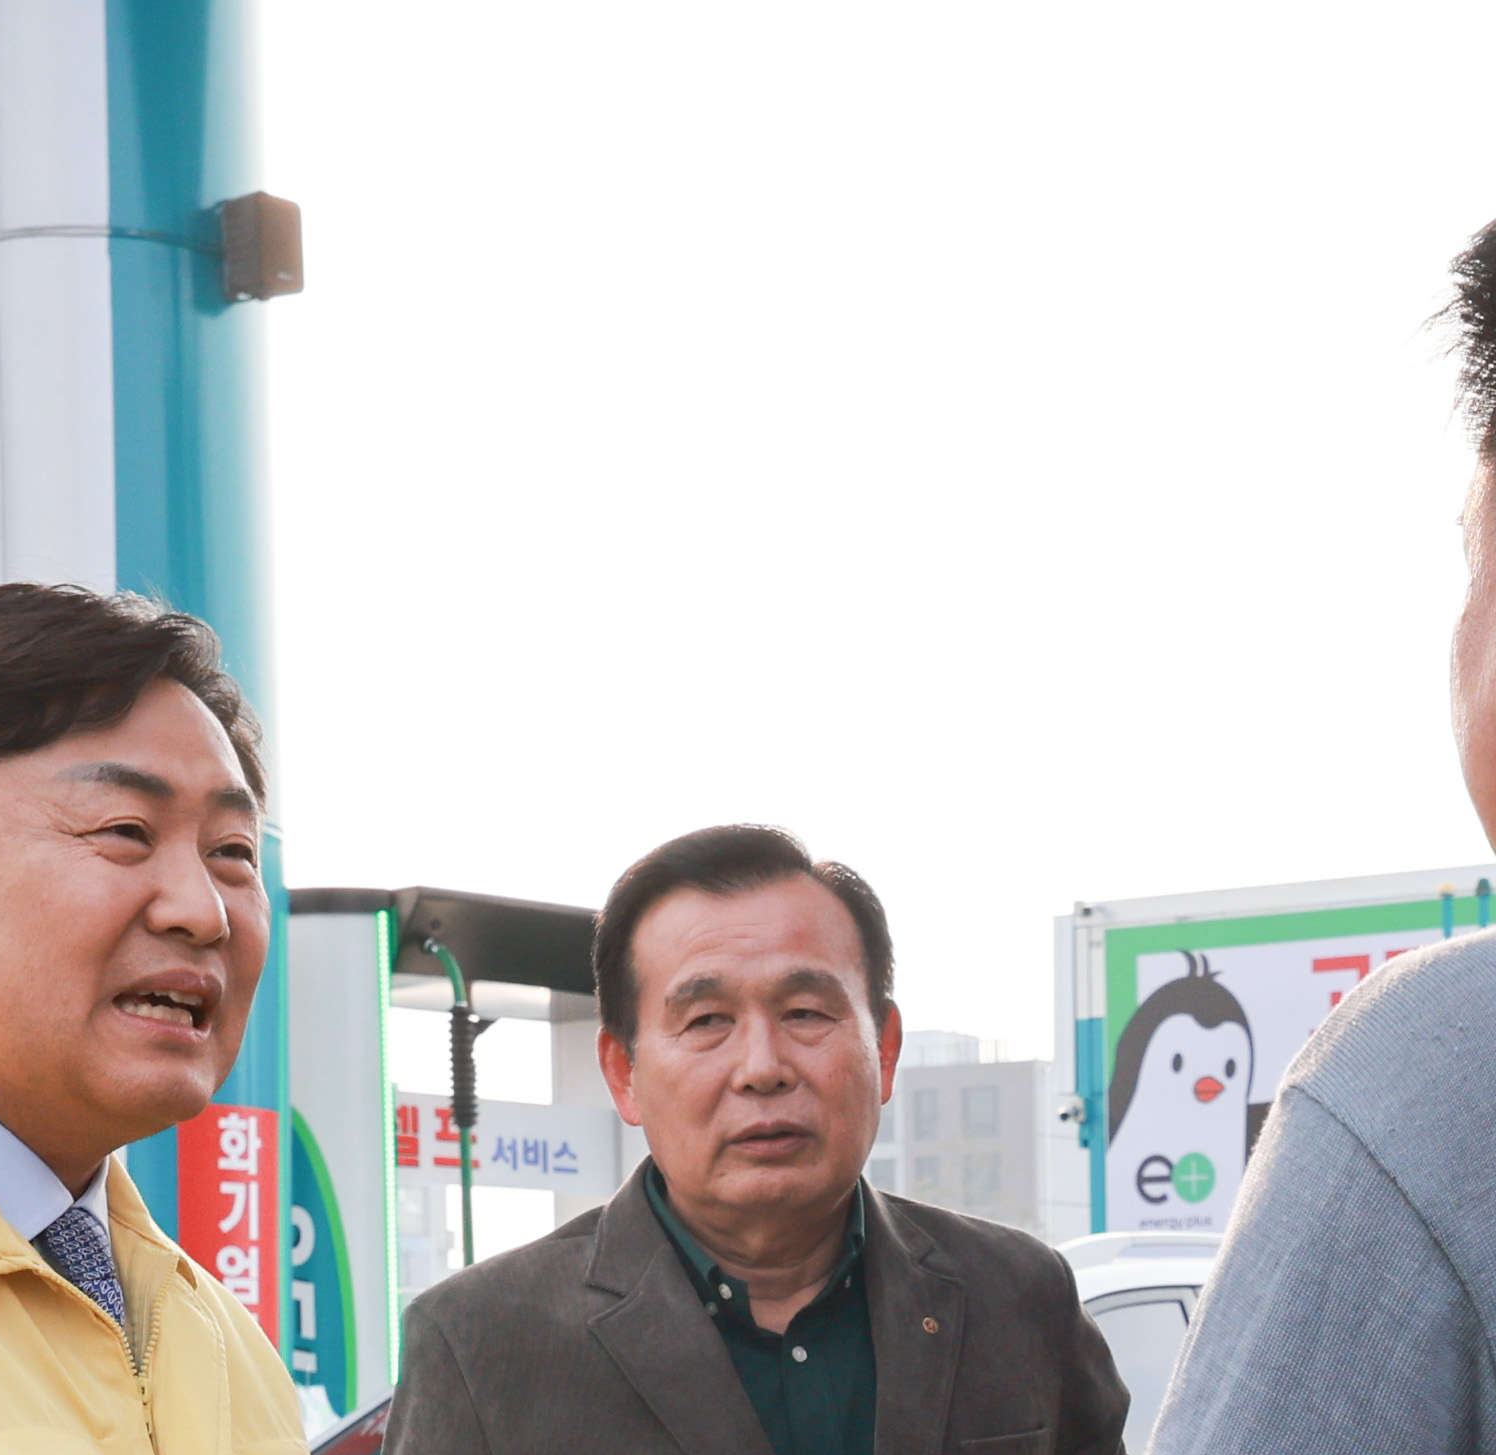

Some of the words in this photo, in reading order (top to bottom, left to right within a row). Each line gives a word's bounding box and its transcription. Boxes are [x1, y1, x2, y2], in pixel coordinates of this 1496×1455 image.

[492, 1136, 579, 1174] 서비스
[215, 1112, 262, 1323] 화기엄
[1138, 1216, 1182, 1230] energy
[1184, 1214, 1213, 1229] plus
